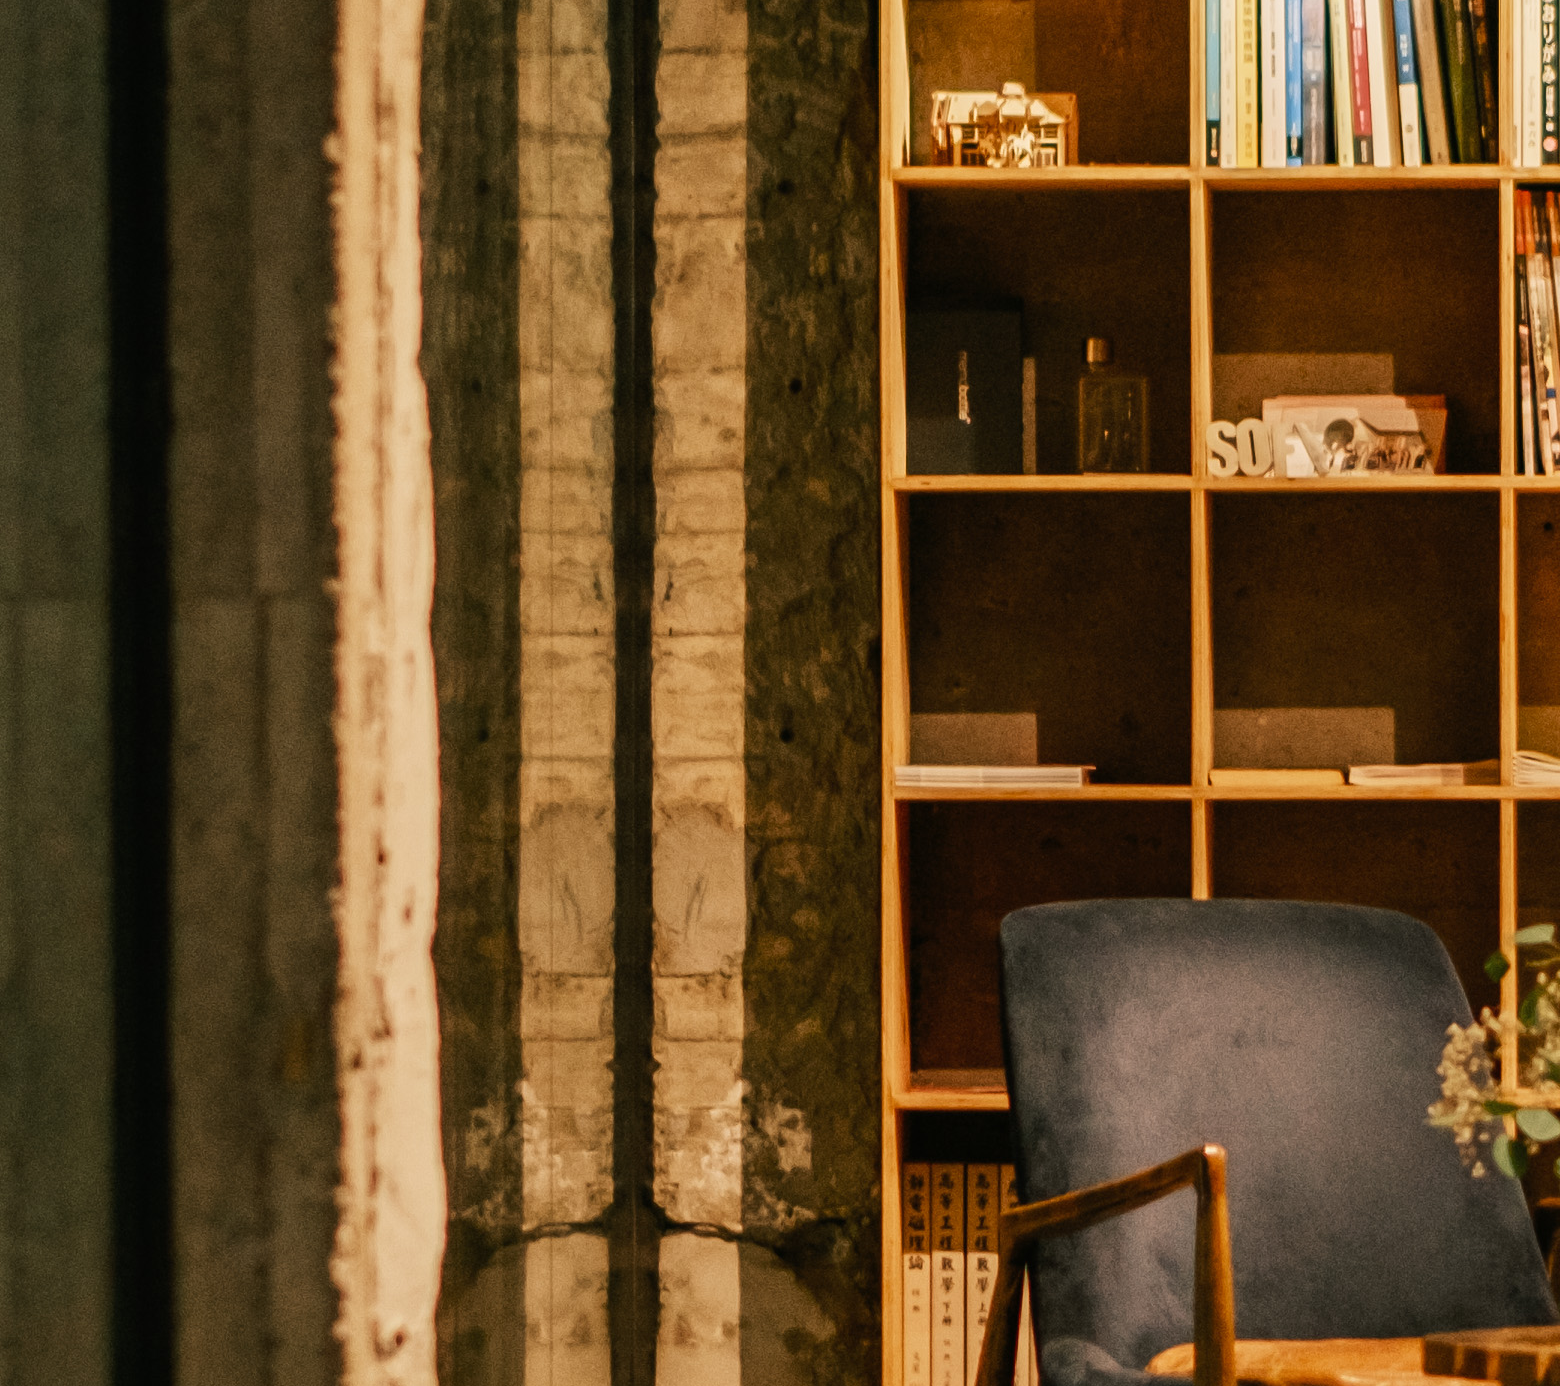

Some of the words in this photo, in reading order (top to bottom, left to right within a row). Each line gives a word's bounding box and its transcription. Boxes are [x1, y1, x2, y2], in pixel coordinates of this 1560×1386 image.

[939, 1172, 956, 1295] 高等工程數學
[974, 1172, 991, 1295] 高等工程數學
